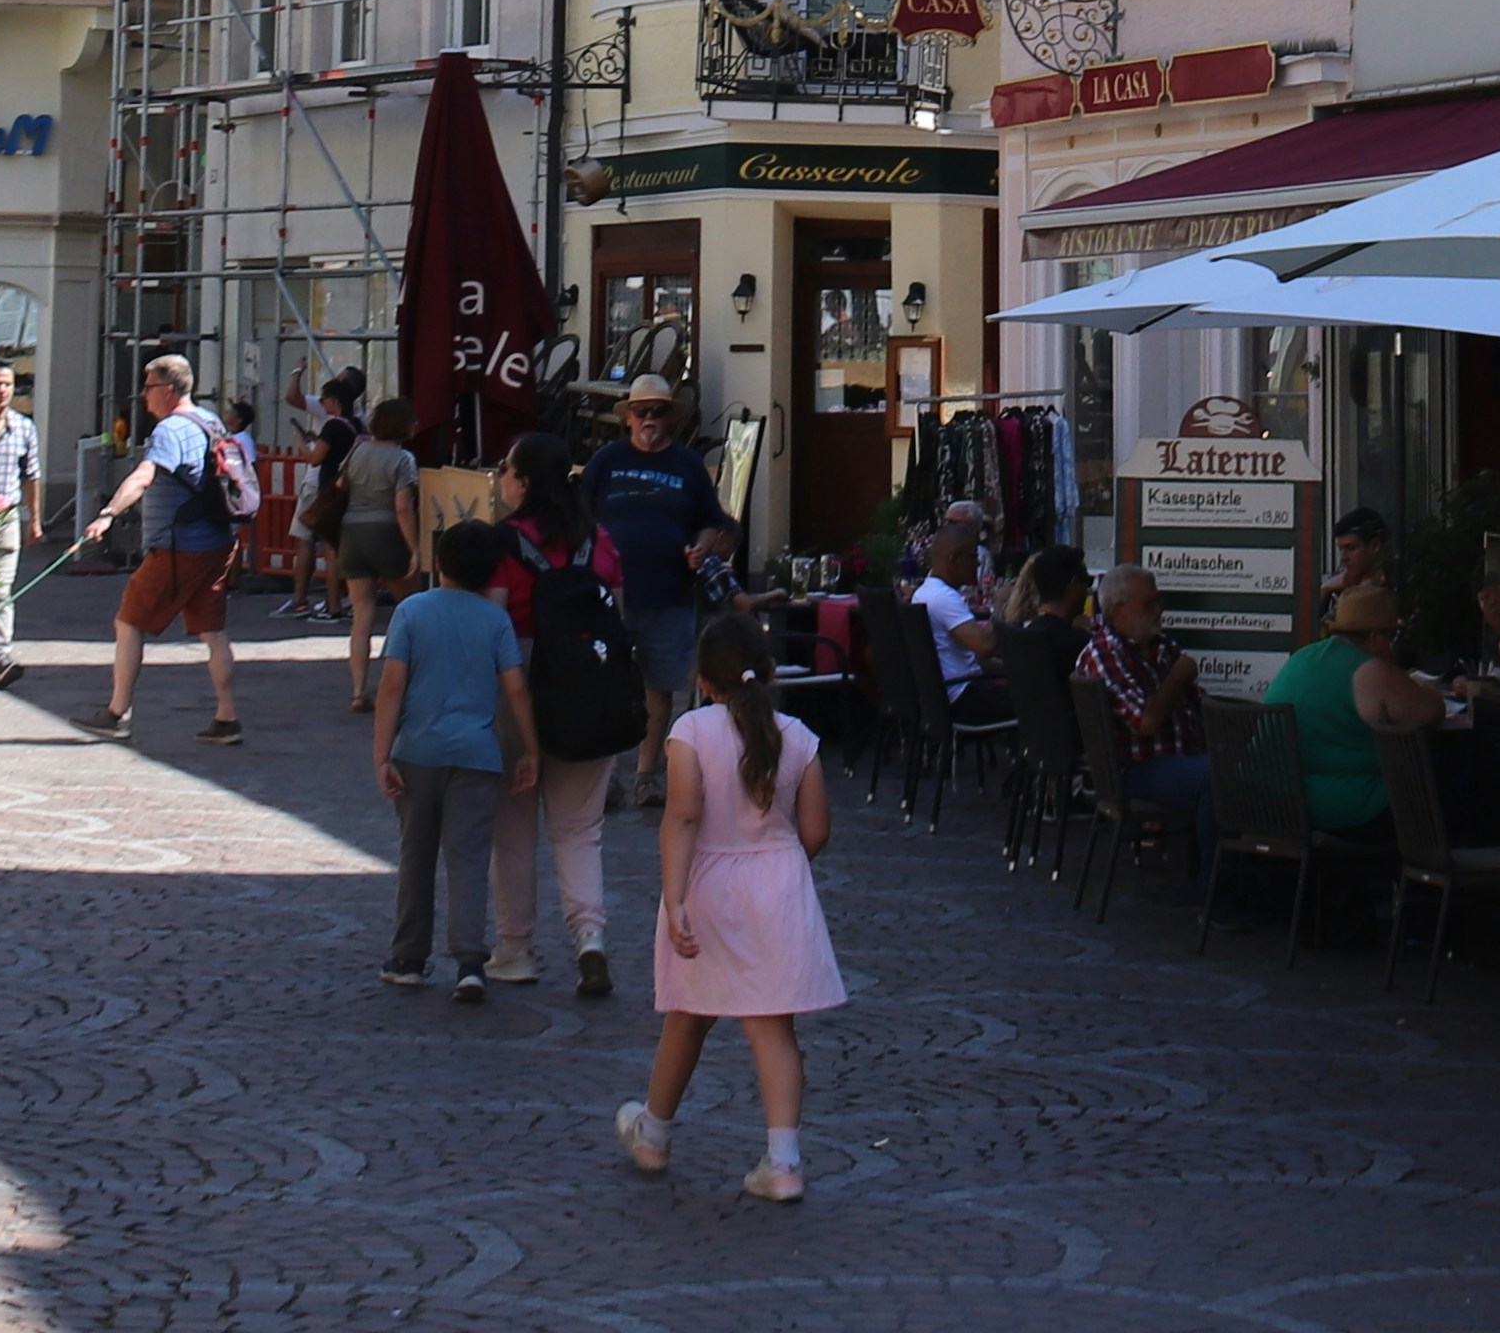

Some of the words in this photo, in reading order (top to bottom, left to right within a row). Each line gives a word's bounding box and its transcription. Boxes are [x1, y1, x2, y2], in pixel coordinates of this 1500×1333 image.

[1093, 75, 1111, 105] LA
[1113, 71, 1150, 101] CASA
[738, 152, 924, 185] Casserole
[1059, 223, 1157, 256] RISTORANTE
[1187, 214, 1277, 247] PIZZERIA
[1156, 440, 1286, 476] Laterne
[1147, 551, 1244, 570] Maultaschen
[1161, 614, 1275, 630] gesempfehlung:
[1198, 657, 1252, 680] felspitz
